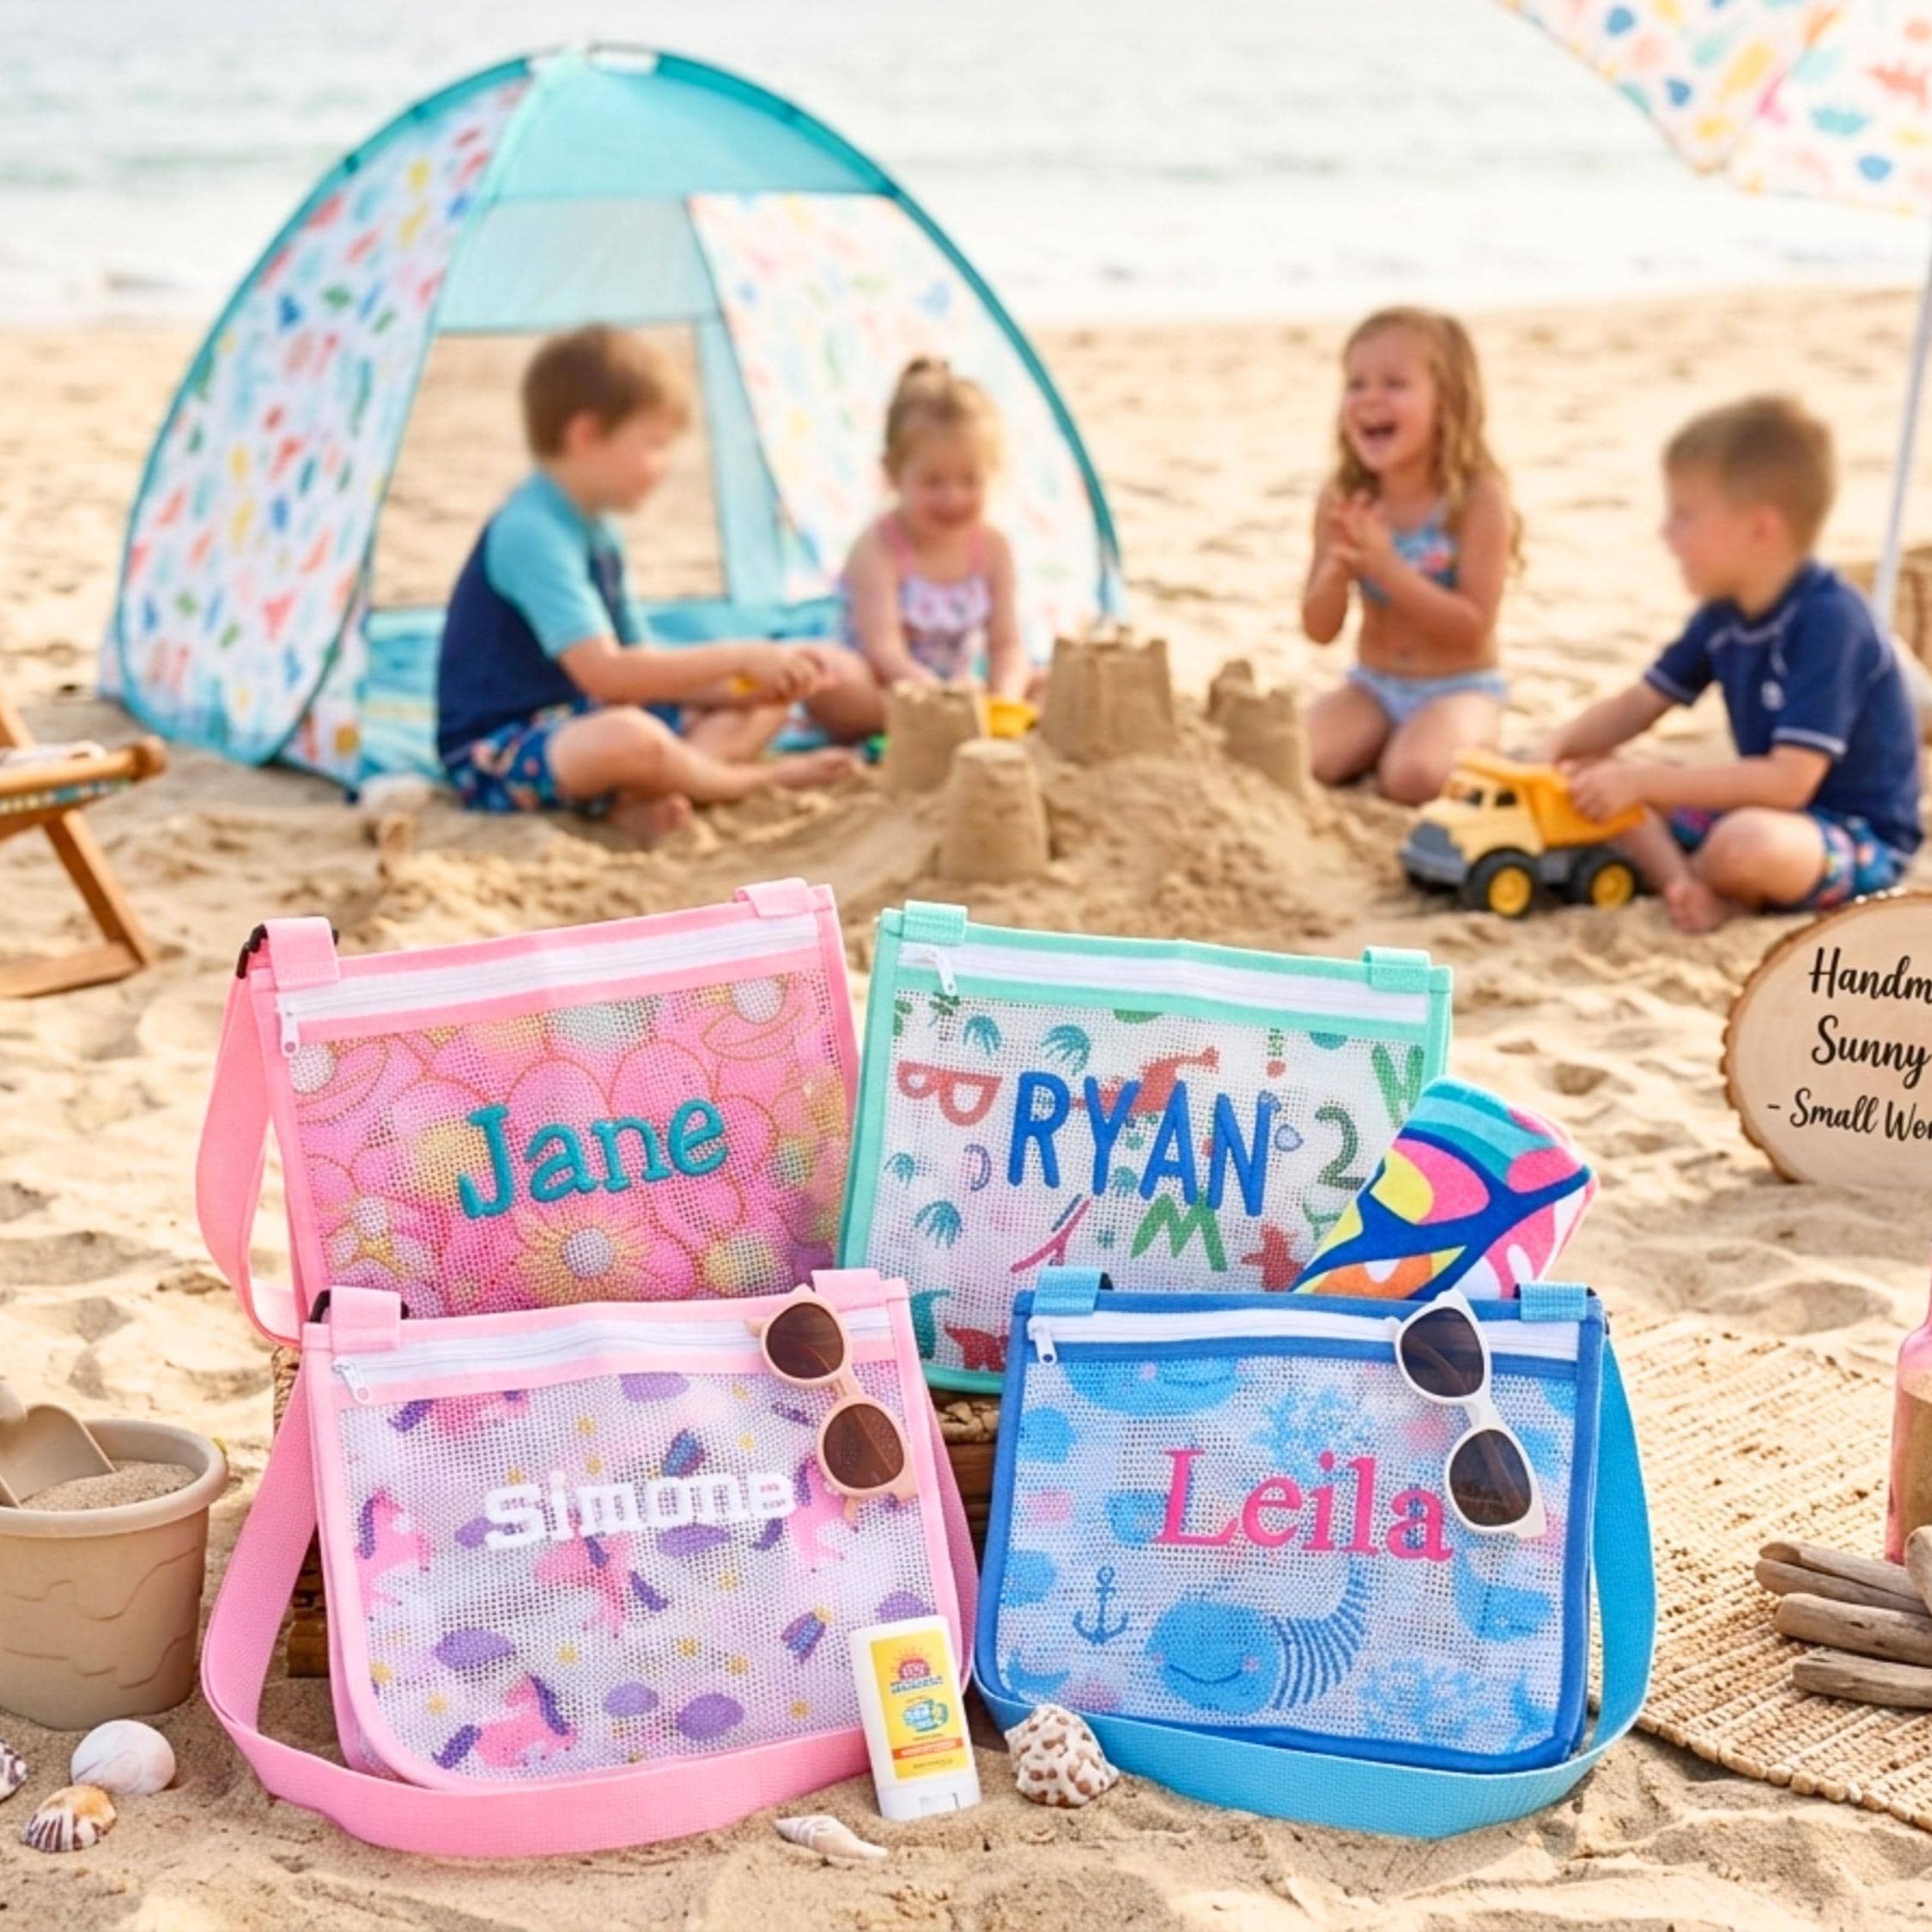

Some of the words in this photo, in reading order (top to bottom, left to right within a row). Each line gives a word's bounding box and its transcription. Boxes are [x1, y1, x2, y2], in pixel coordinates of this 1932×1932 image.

[1811, 1014, 1932, 1090] Sunny
[456, 1097, 729, 1219] Jane
[1006, 1071, 1276, 1218] RYAN
[1789, 1087, 1879, 1134] Small
[484, 1470, 796, 1550] Simone
[1151, 1449, 1454, 1562] Leila
